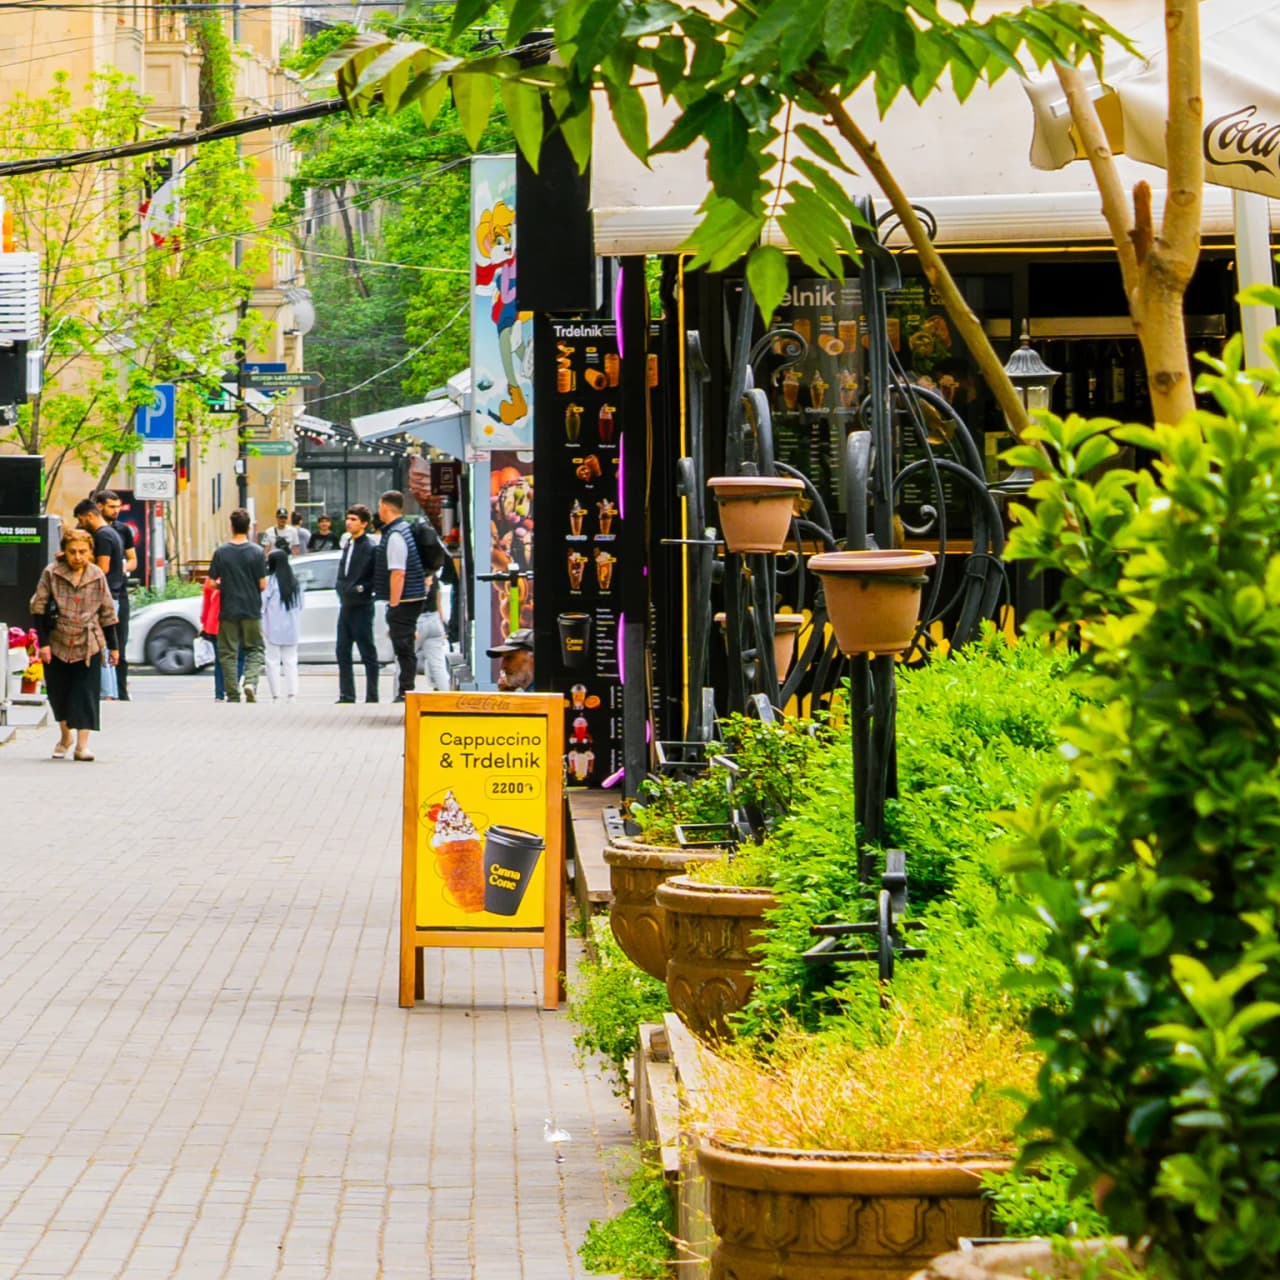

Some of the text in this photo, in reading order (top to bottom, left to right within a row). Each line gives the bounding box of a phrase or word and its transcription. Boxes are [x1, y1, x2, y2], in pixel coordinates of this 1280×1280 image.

[553, 325, 603, 337] Trdelnik
[439, 732, 542, 749] Cappuccino
[439, 753, 541, 769] & Trdelnik
[490, 863, 521, 880] Cinna
[489, 875, 517, 891] Cone
